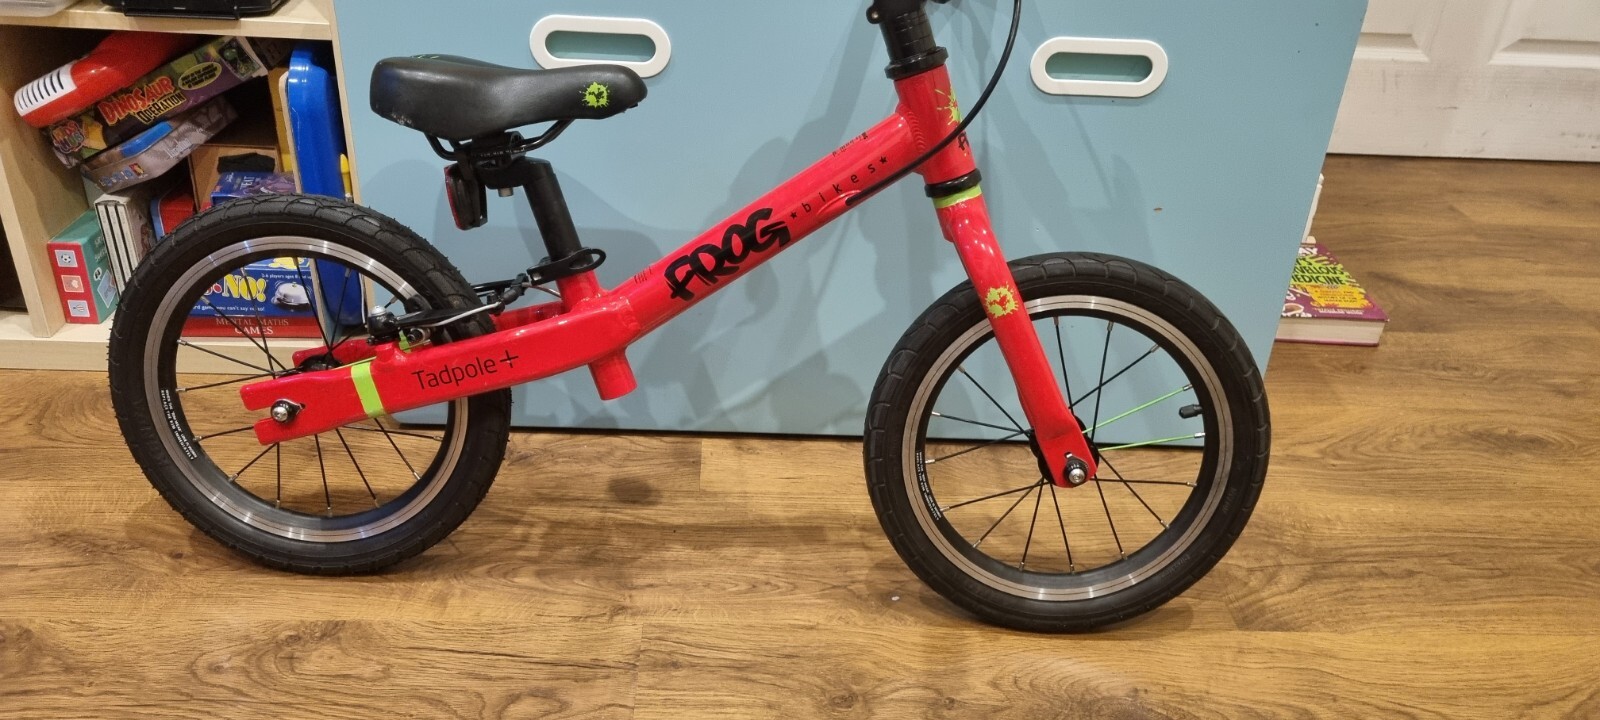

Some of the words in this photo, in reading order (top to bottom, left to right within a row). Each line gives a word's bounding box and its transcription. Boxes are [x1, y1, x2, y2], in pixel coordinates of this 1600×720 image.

[98, 76, 175, 125] DINOSAUR
[136, 91, 185, 123] OPERATION
[664, 208, 791, 301] FROG
[802, 164, 876, 213] bikes
[222, 273, 267, 302] NO!
[216, 317, 255, 326] MENTAL
[261, 318, 289, 326] MATHS
[234, 326, 274, 335] GAMES
[411, 357, 498, 390] Tadpole
